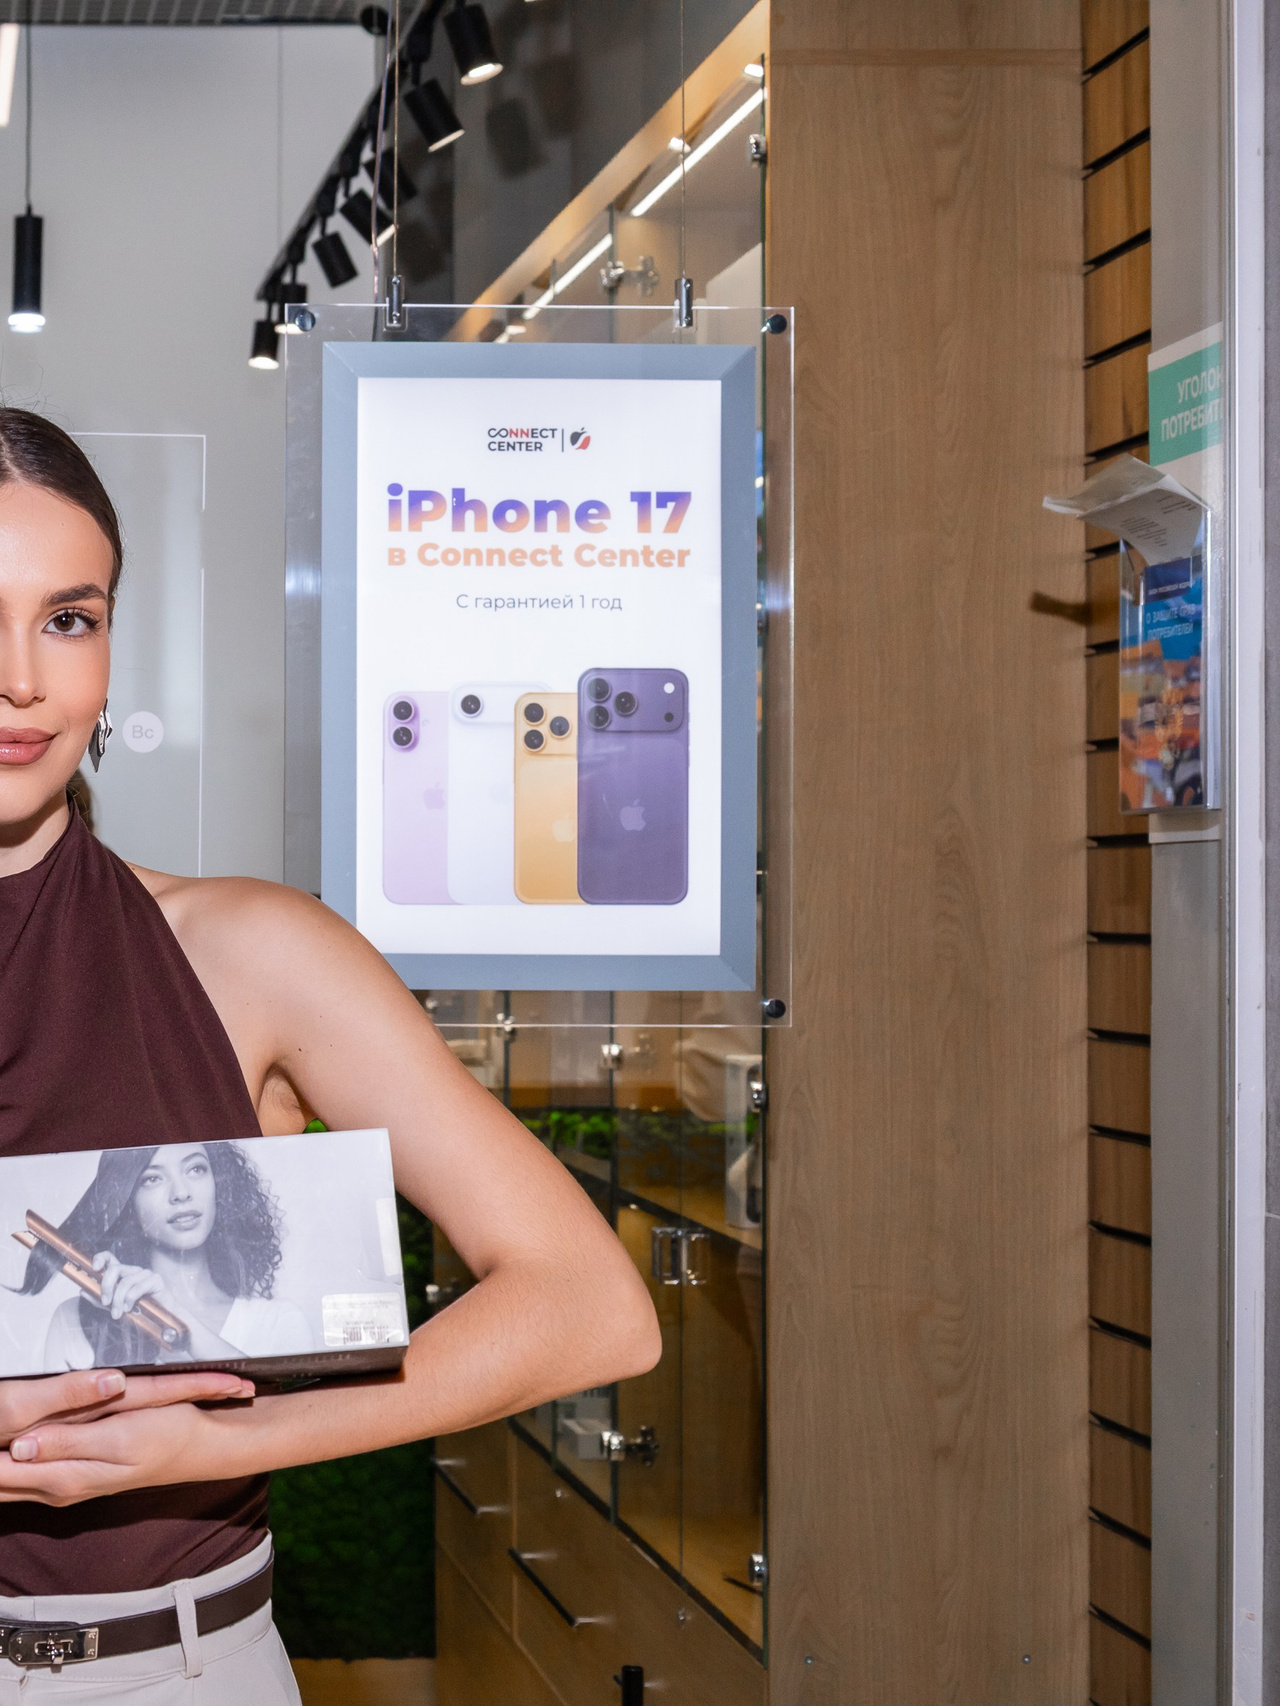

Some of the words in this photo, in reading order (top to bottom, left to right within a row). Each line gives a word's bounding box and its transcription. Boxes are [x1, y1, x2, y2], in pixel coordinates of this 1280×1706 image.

[487, 427, 558, 439] CONNECT
[487, 441, 543, 452] CENTER
[387, 482, 611, 534] iPhone
[630, 491, 692, 534] 17
[387, 547, 406, 567] в
[417, 542, 563, 567] Connect
[574, 543, 691, 568] Center
[456, 594, 469, 609] С
[474, 594, 573, 612] гарантией
[579, 594, 586, 609] 1
[591, 597, 623, 612] год
[132, 725, 154, 739] Вс
